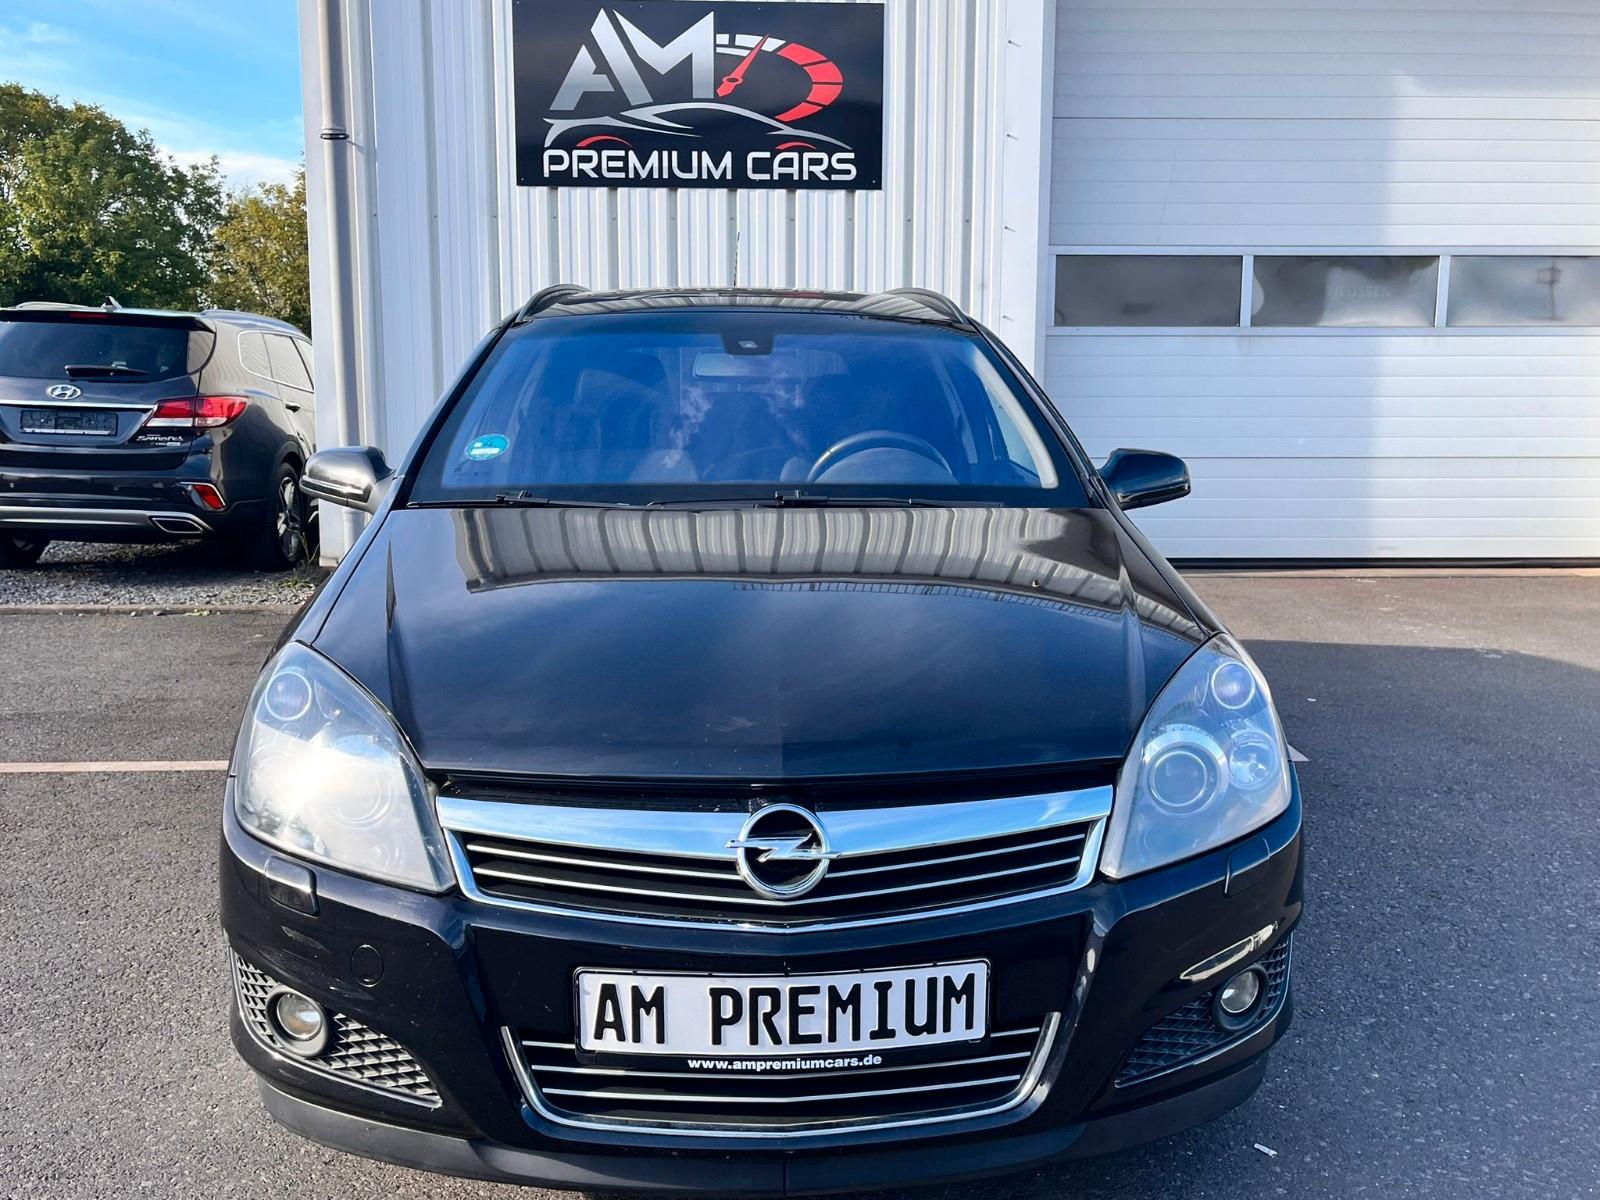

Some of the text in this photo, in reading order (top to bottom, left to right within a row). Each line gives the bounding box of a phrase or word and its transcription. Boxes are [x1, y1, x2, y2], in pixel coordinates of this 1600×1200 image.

[543, 148, 857, 181] PREMIUM CARS
[593, 972, 976, 1046] AM PREMIUM
[687, 1054, 882, 1072] www.ampremiumcars.de
